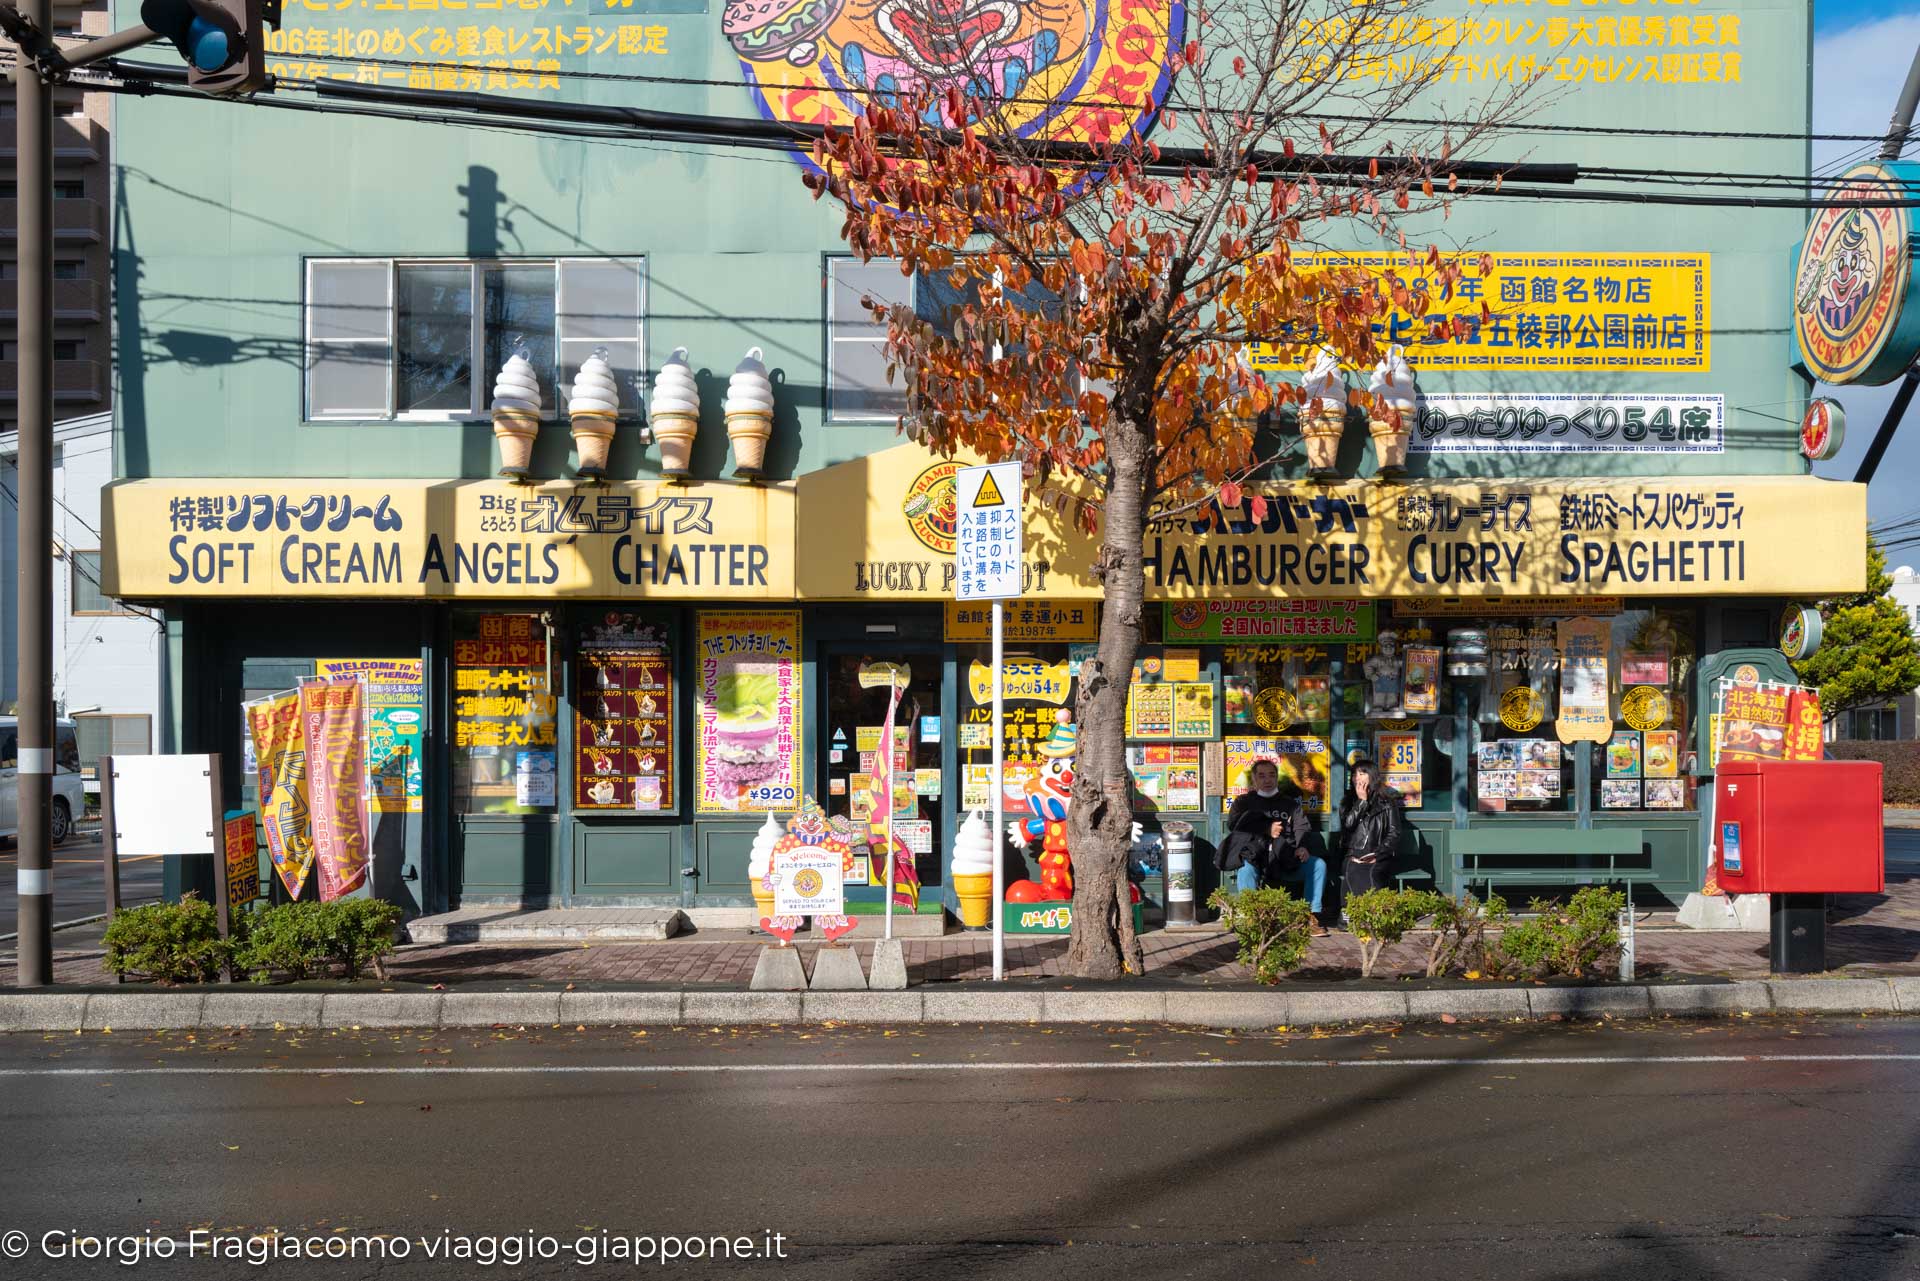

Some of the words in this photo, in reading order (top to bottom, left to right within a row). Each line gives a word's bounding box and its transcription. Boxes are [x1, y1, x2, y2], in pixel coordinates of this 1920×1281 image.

[1500, 276, 1652, 304] 函館名物店
[1805, 310, 1845, 365] LUCKY
[1849, 243, 1896, 359] PIERROT
[1417, 404, 1711, 442] ゆったりゆっくり54席
[479, 494, 518, 514] Big
[521, 495, 714, 535] オムライス
[1397, 496, 1428, 514] 自家製
[1427, 493, 1533, 532] カレーライス
[1560, 493, 1745, 531] 鉄板ミートスパゲッティ
[480, 515, 517, 532] とろとろ
[914, 515, 954, 551] LUCKY
[1397, 516, 1428, 533] こだわり
[960, 512, 974, 596] 入れています
[975, 511, 988, 593] 道路に溝を
[989, 509, 1003, 584] 抑制の為、
[1003, 508, 1017, 574] スピード
[168, 534, 255, 584] SOFT
[279, 534, 402, 584] CREAM
[612, 534, 769, 586] CHATTER
[1408, 533, 1527, 584] CURRY
[1560, 533, 1746, 583] SPAGHETTI
[854, 561, 931, 592] LUCKY
[483, 617, 529, 637] 函館
[1020, 609, 1085, 625] 幸運小丑
[985, 626, 1057, 637] 始於1987年
[702, 636, 726, 657] THE
[726, 633, 793, 655] フトッチョバーガー
[325, 661, 396, 673] WELCOME
[375, 671, 421, 681] PIERROT
[1728, 690, 1787, 709] 北海道
[1728, 704, 1785, 724] 大自然肉力
[504, 720, 557, 746] 大人気
[1396, 744, 1414, 765] 35
[750, 787, 795, 800] ¥920
[228, 854, 257, 876] ゆったり
[790, 852, 829, 863] Welcome
[229, 874, 259, 904] 53席
